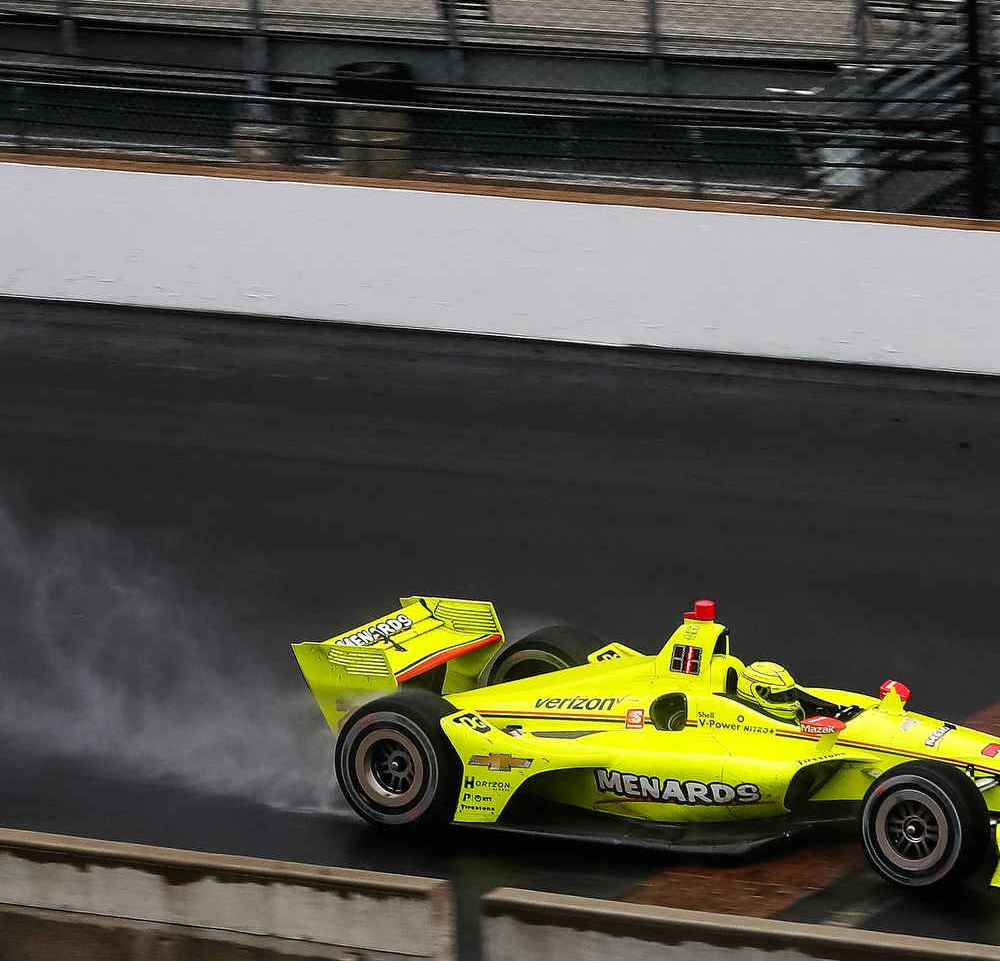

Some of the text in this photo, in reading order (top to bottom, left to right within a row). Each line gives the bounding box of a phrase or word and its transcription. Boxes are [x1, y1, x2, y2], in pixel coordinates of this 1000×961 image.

[335, 614, 414, 647] MENARDS
[535, 695, 616, 711] verizon
[698, 711, 715, 719] Shell
[699, 719, 741, 731] V-Power
[800, 724, 835, 733] Mazak
[595, 768, 761, 805] MENARDS
